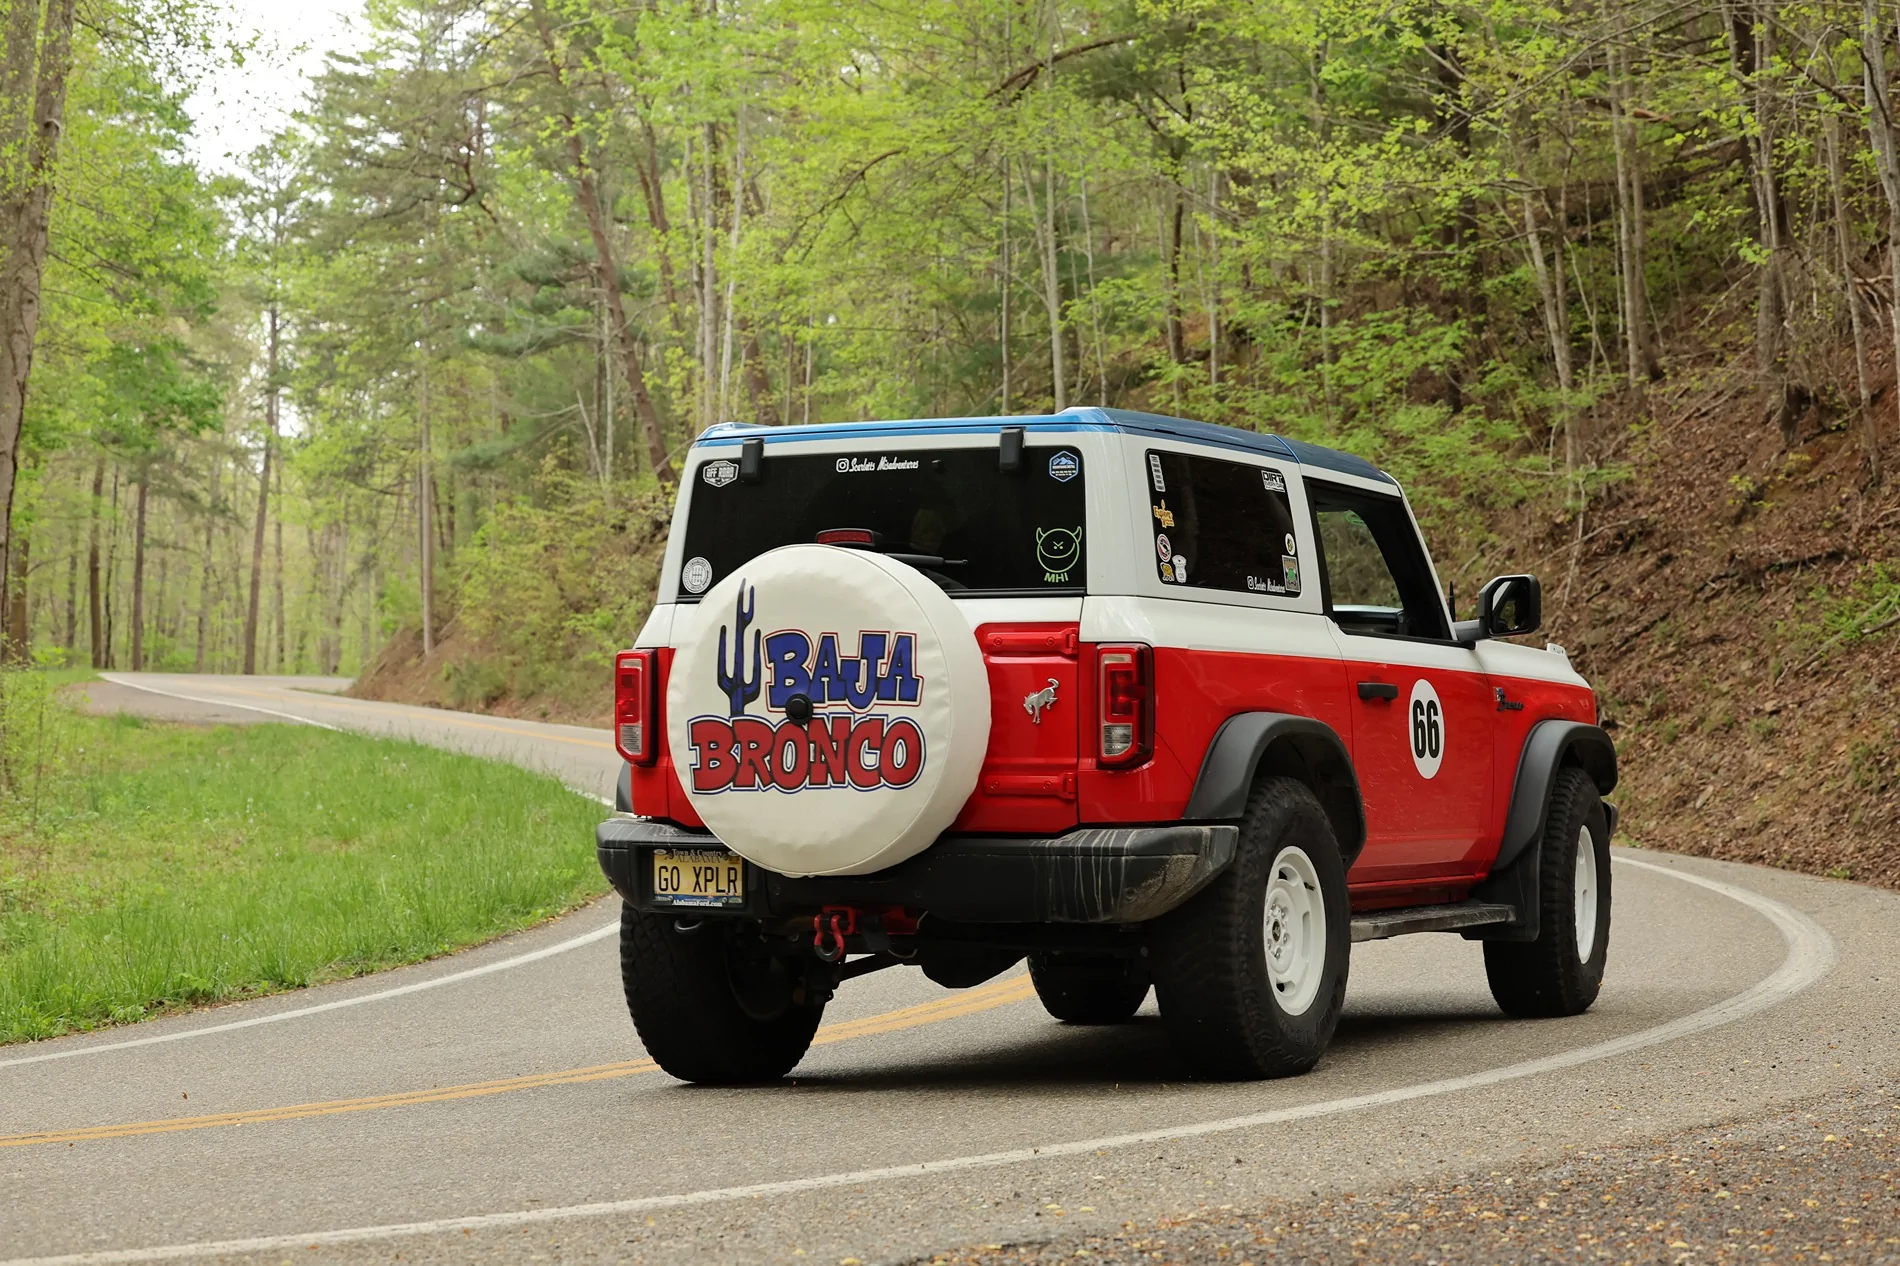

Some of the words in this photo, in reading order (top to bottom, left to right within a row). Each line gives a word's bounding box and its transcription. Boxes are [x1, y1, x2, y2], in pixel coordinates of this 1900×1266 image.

[706, 467, 718, 478] OFF
[1262, 472, 1282, 483] DIRT
[1044, 572, 1069, 583] MHI
[763, 630, 923, 712] BAJA
[1412, 699, 1440, 759] 66
[688, 714, 925, 794] BRONCO
[672, 849, 688, 857] Town
[697, 849, 722, 857] Country
[658, 865, 680, 892] GO
[692, 866, 738, 894] XPLR
